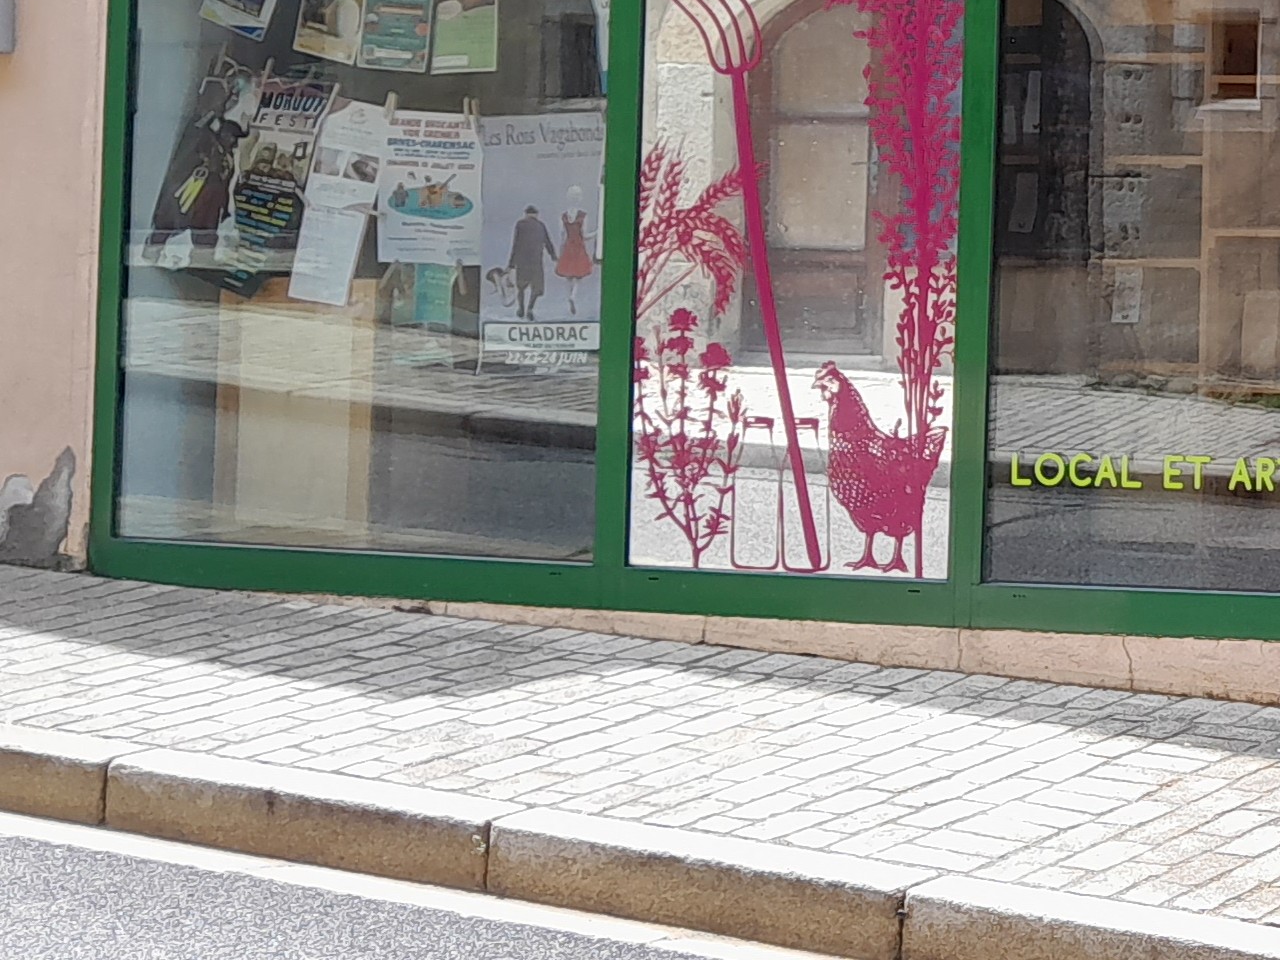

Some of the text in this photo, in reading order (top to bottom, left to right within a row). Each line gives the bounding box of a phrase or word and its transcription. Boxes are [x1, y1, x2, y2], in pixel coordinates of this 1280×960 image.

[508, 326, 589, 342] CHADRAC
[1010, 452, 1143, 490] LOCAL
[1163, 455, 1210, 491] ET
